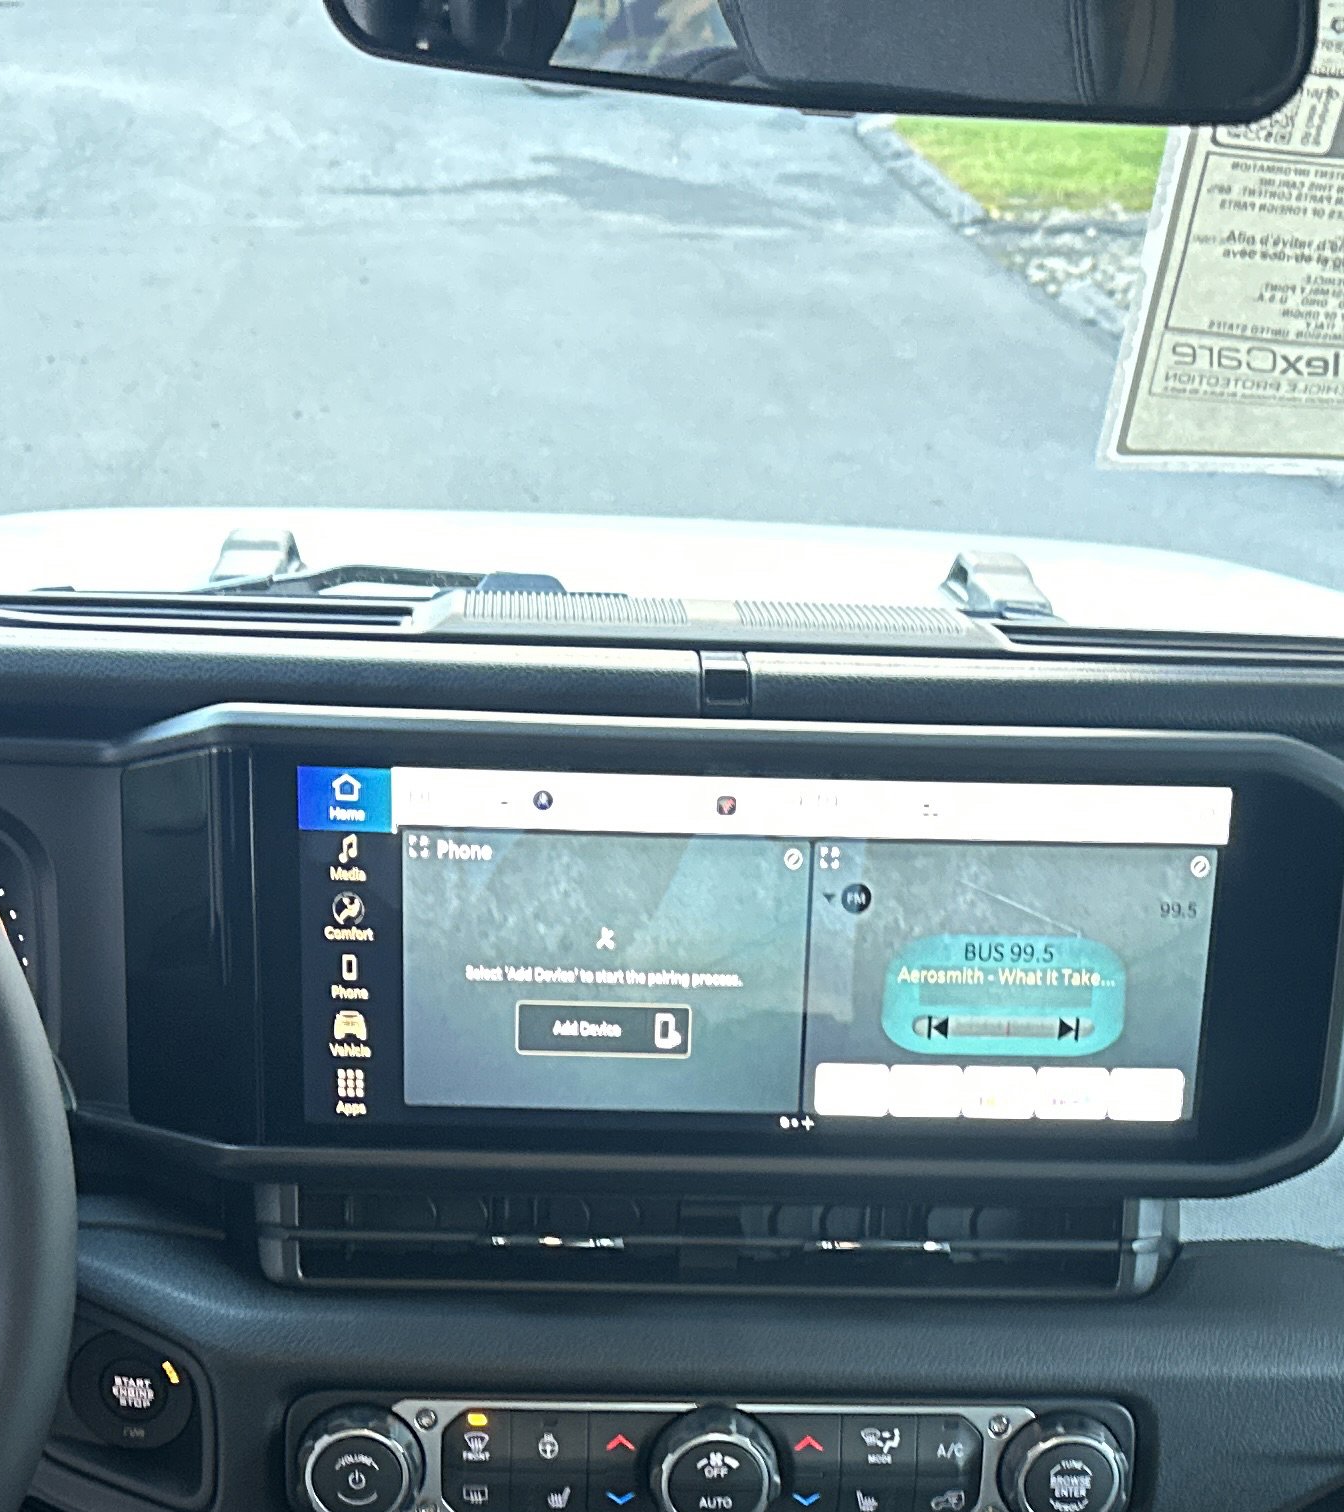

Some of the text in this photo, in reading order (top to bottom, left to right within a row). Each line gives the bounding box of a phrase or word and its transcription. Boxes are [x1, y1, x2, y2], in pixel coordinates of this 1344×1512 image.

[328, 806, 366, 822] Home
[436, 839, 493, 861] Phone
[329, 866, 368, 882] Media
[1159, 902, 1198, 919] 99.5
[323, 926, 375, 942] Comfort
[963, 942, 1055, 964] BUS 99.5
[465, 964, 503, 982] Select
[580, 967, 594, 984] to
[595, 968, 625, 985] start
[625, 969, 646, 985] the
[647, 970, 690, 989] pairing
[897, 965, 985, 985] Aerosmith
[997, 966, 1043, 986] What
[1045, 967, 1059, 986] It
[331, 984, 369, 1001] Phone
[552, 1019, 623, 1038] Add Device
[329, 1041, 373, 1059] Vehicle
[335, 1100, 368, 1117] Apps
[462, 1450, 491, 1462] FRONT
[936, 1444, 965, 1460] A/C
[704, 1466, 729, 1480] OFF
[1049, 1474, 1092, 1489] BROWSE
[1054, 1486, 1088, 1499] ENTER
[699, 1495, 733, 1511] AUTO
